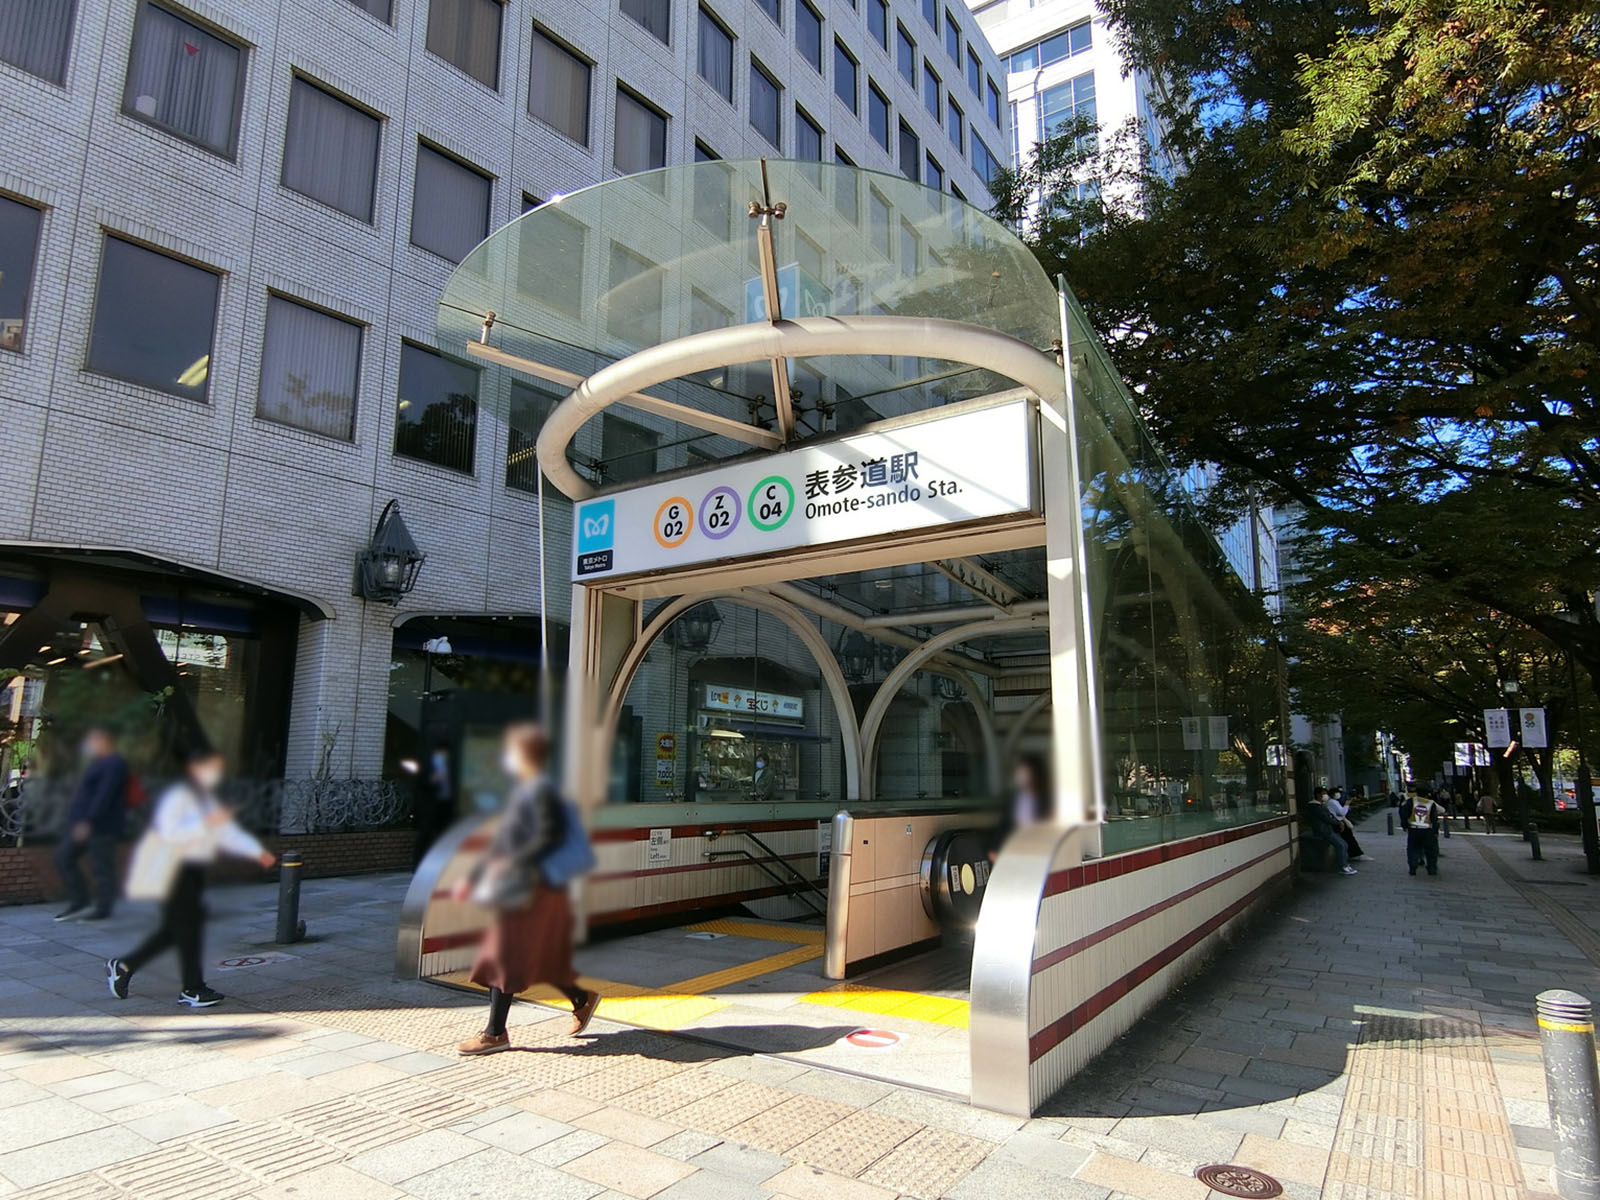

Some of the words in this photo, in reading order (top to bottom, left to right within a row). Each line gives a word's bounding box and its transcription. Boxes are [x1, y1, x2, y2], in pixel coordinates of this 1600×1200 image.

[805, 451, 919, 500] 表参道駅
[766, 485, 776, 500] C
[805, 485, 921, 519] Omote-sando
[927, 480, 963, 499] Sta.
[715, 495, 725, 510] Z
[760, 502, 782, 520] 04
[668, 505, 680, 520] G
[709, 511, 730, 529] 02
[664, 521, 683, 538] 02
